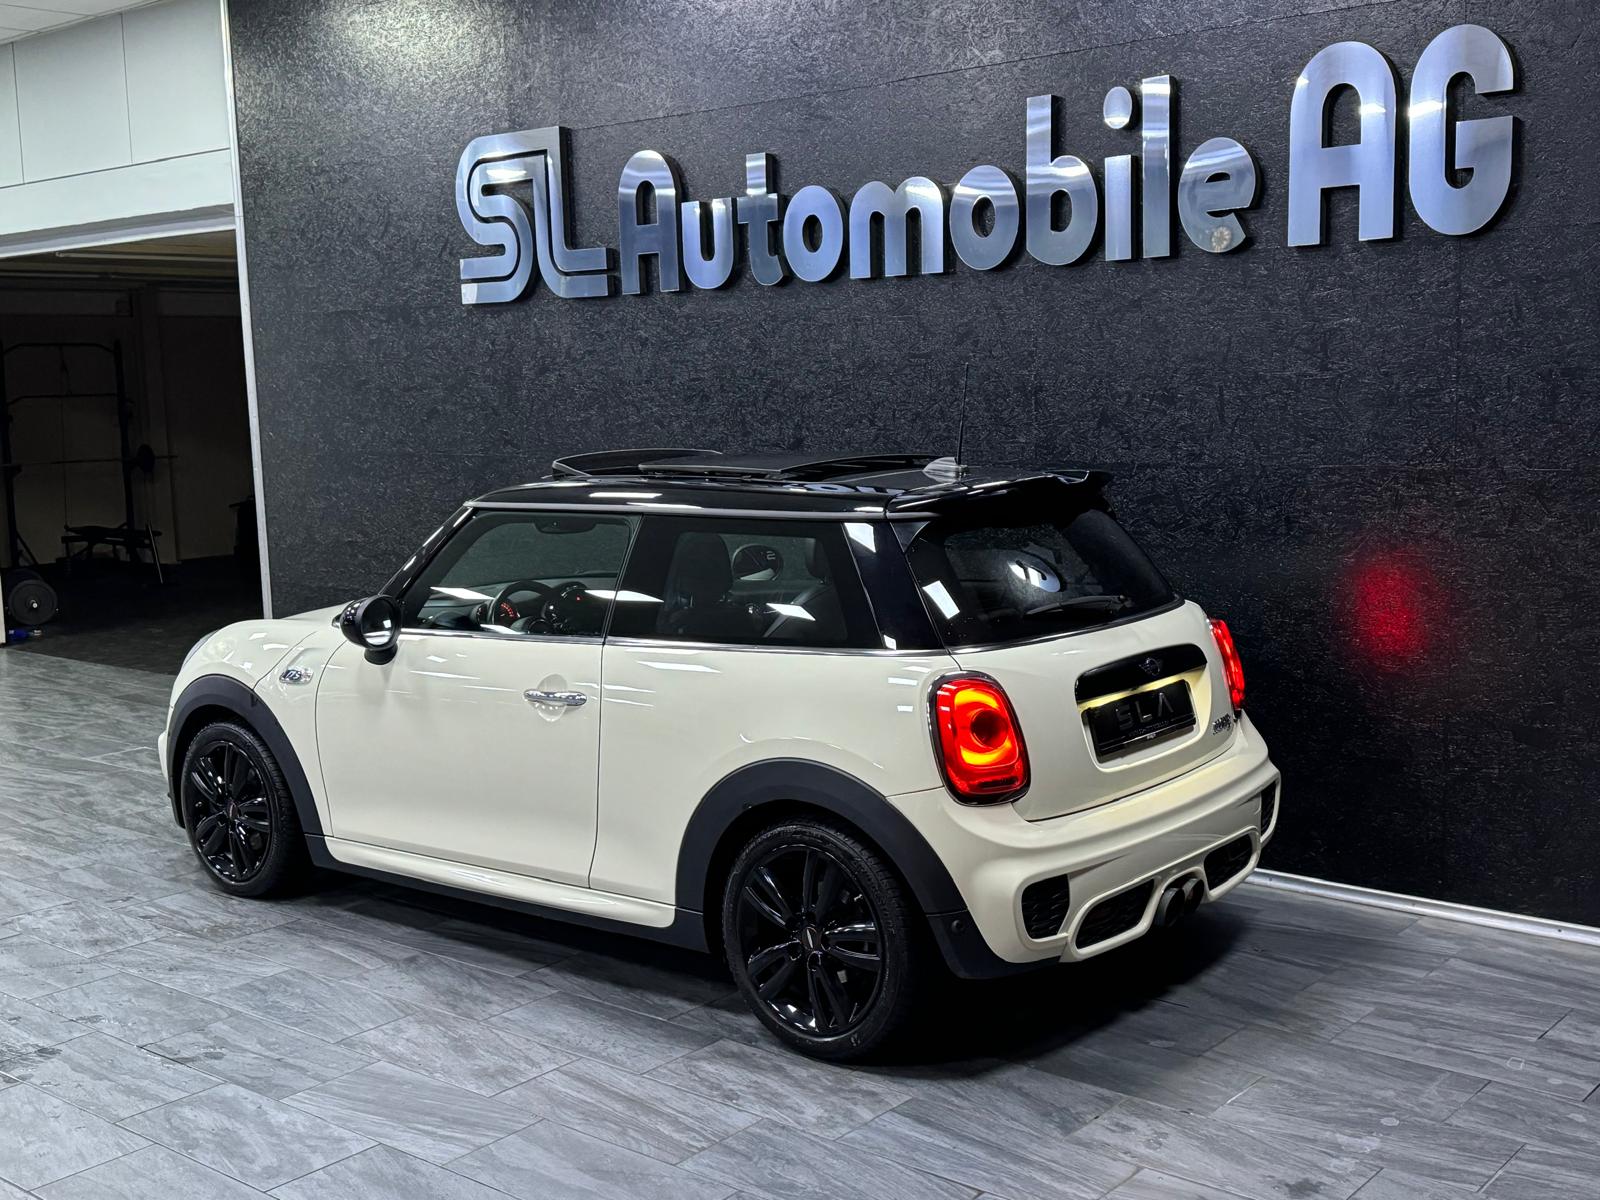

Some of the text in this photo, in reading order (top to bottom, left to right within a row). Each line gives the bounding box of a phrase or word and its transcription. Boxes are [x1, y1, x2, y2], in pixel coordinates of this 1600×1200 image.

[455, 24, 1514, 305] SL Automobile AG
